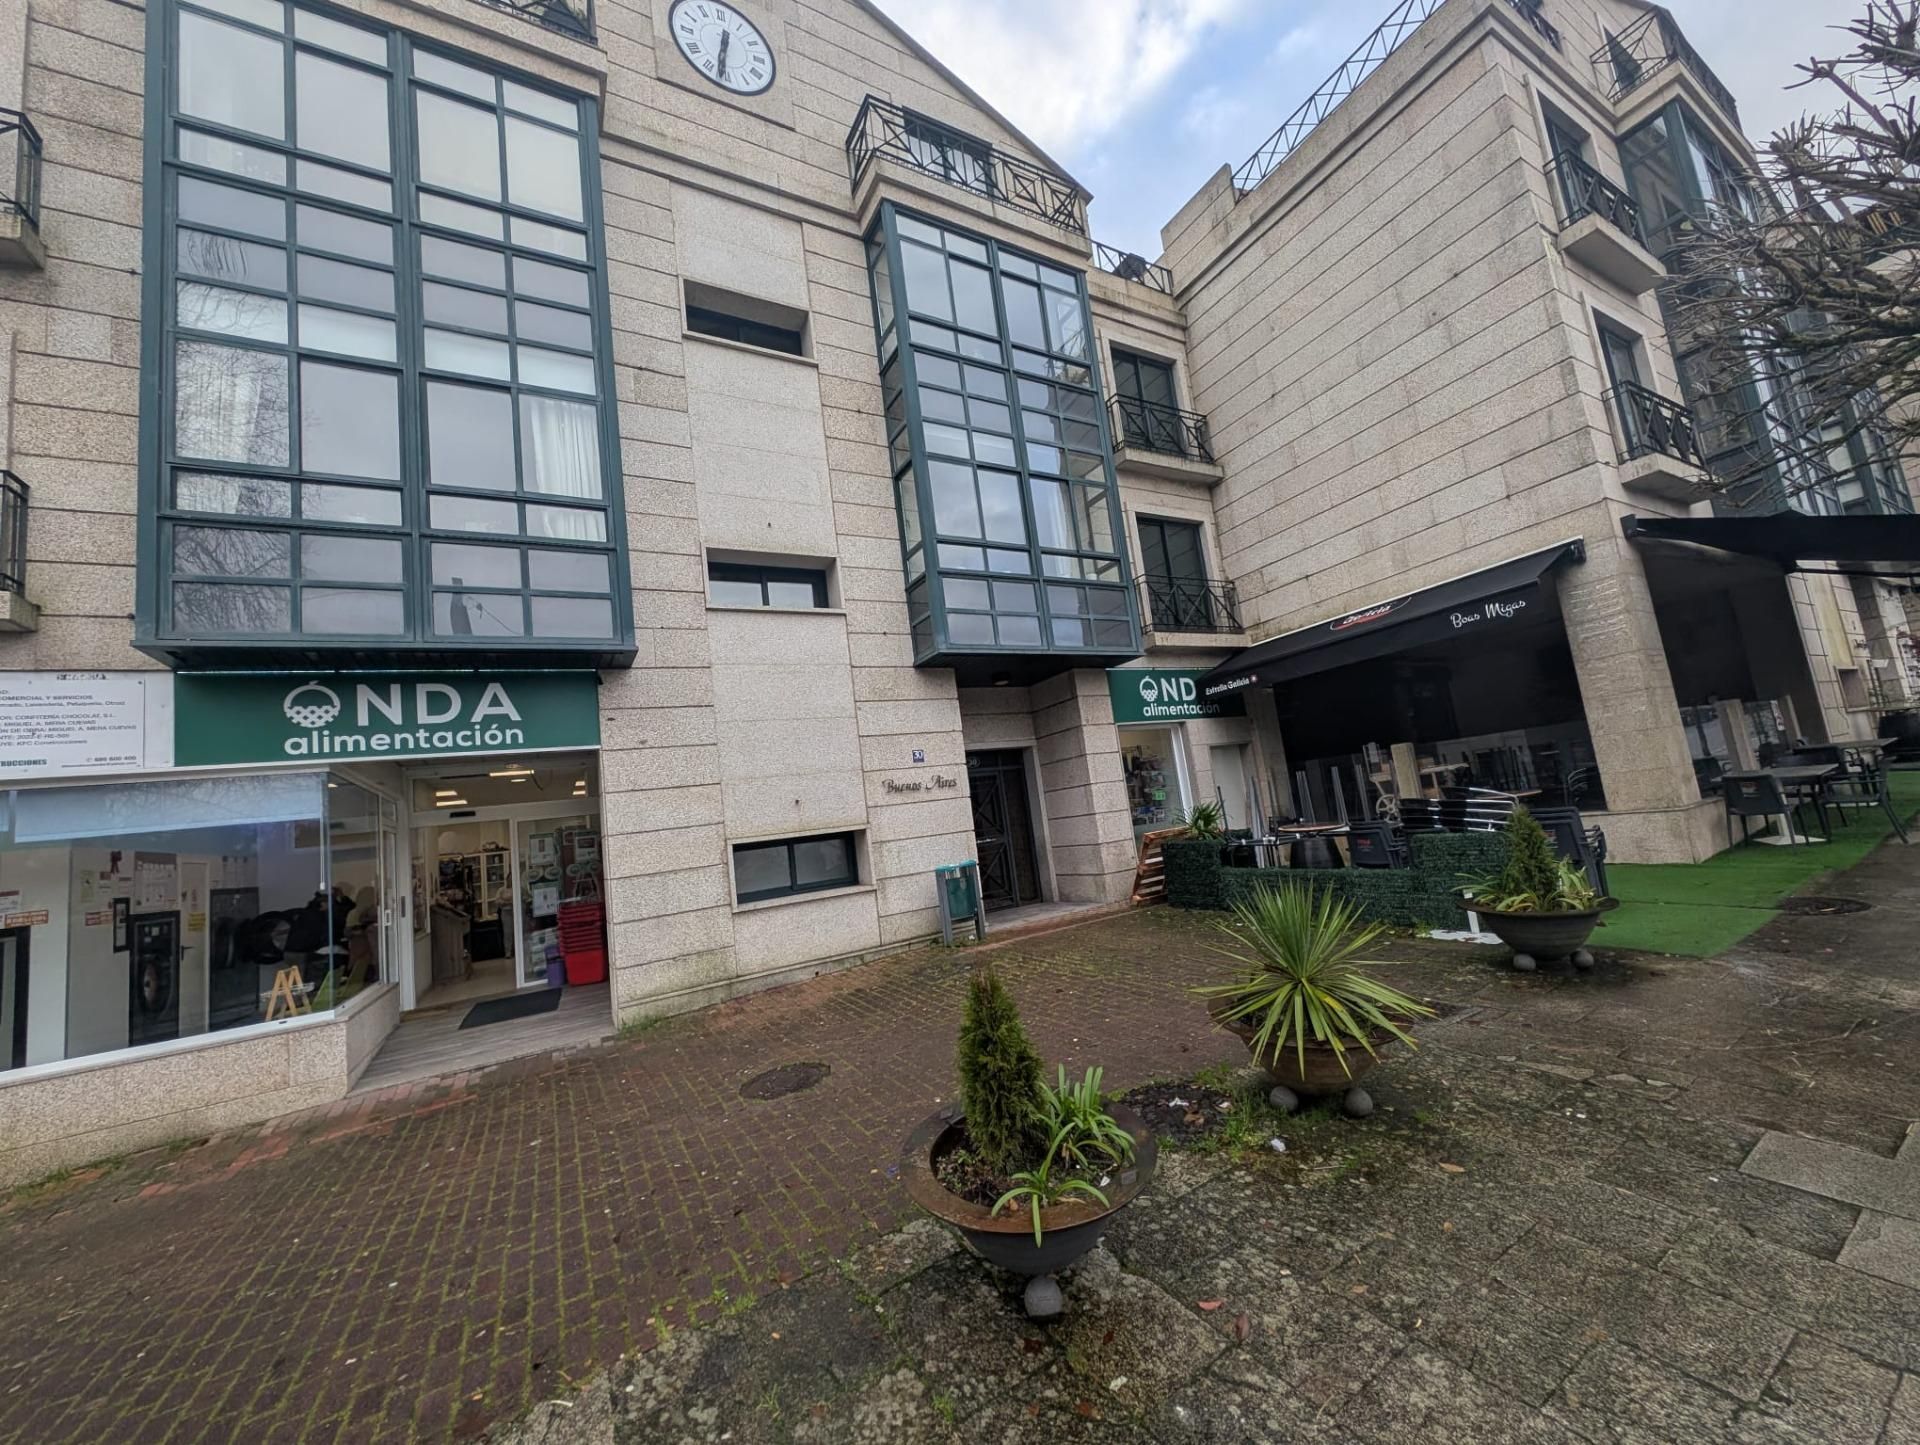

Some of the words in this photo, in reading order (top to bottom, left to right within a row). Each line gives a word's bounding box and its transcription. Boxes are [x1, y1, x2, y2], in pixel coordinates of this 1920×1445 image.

[1450, 612, 1481, 628] Boas
[1485, 599, 1526, 619] Migas
[1205, 683, 1227, 696] Estrella
[1227, 677, 1250, 690] Galicia
[1143, 702, 1221, 717] alimentación
[284, 723, 524, 756] alimentación
[881, 778, 922, 794] Buenos
[925, 775, 957, 791] Aires
